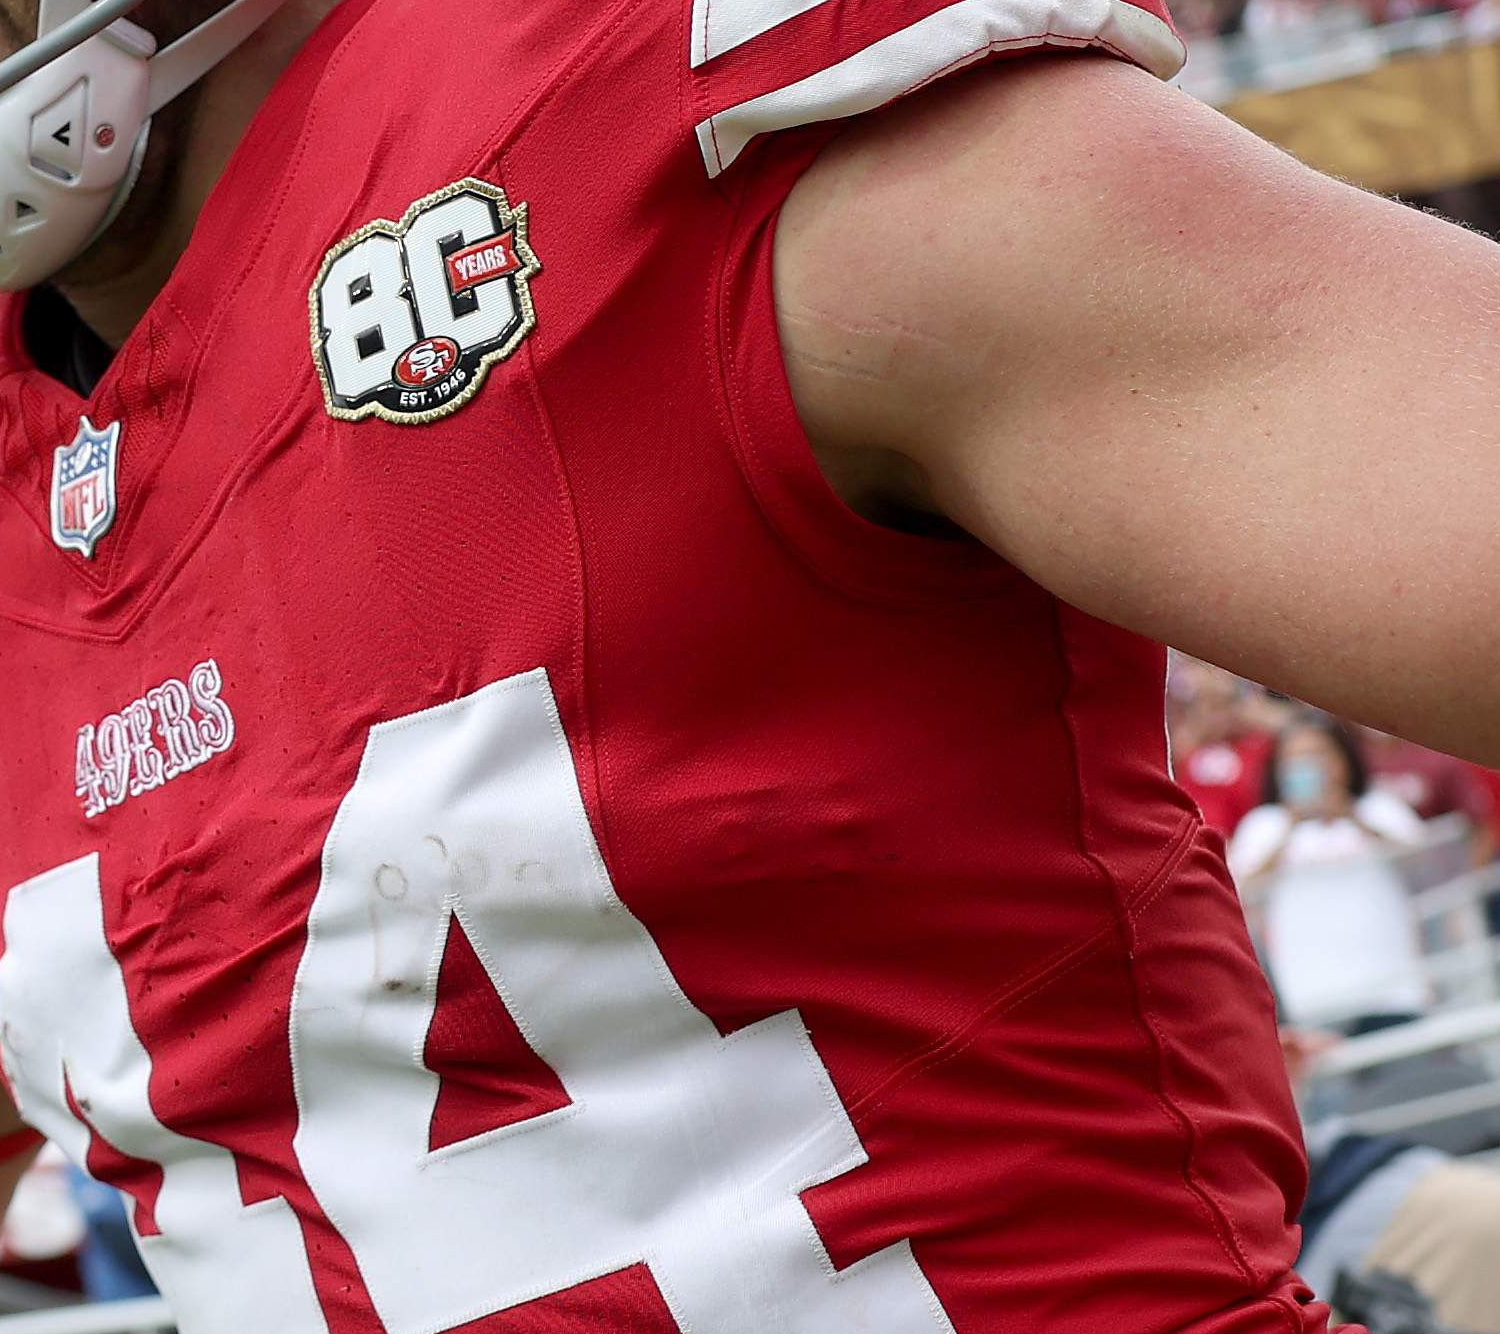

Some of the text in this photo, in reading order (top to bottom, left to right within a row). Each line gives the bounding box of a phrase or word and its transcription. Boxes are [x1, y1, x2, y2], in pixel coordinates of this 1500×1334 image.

[454, 243, 507, 282] YEARS
[400, 368, 466, 406] EST. 1946
[62, 475, 105, 530] NFL
[75, 657, 236, 818] 49ERS
